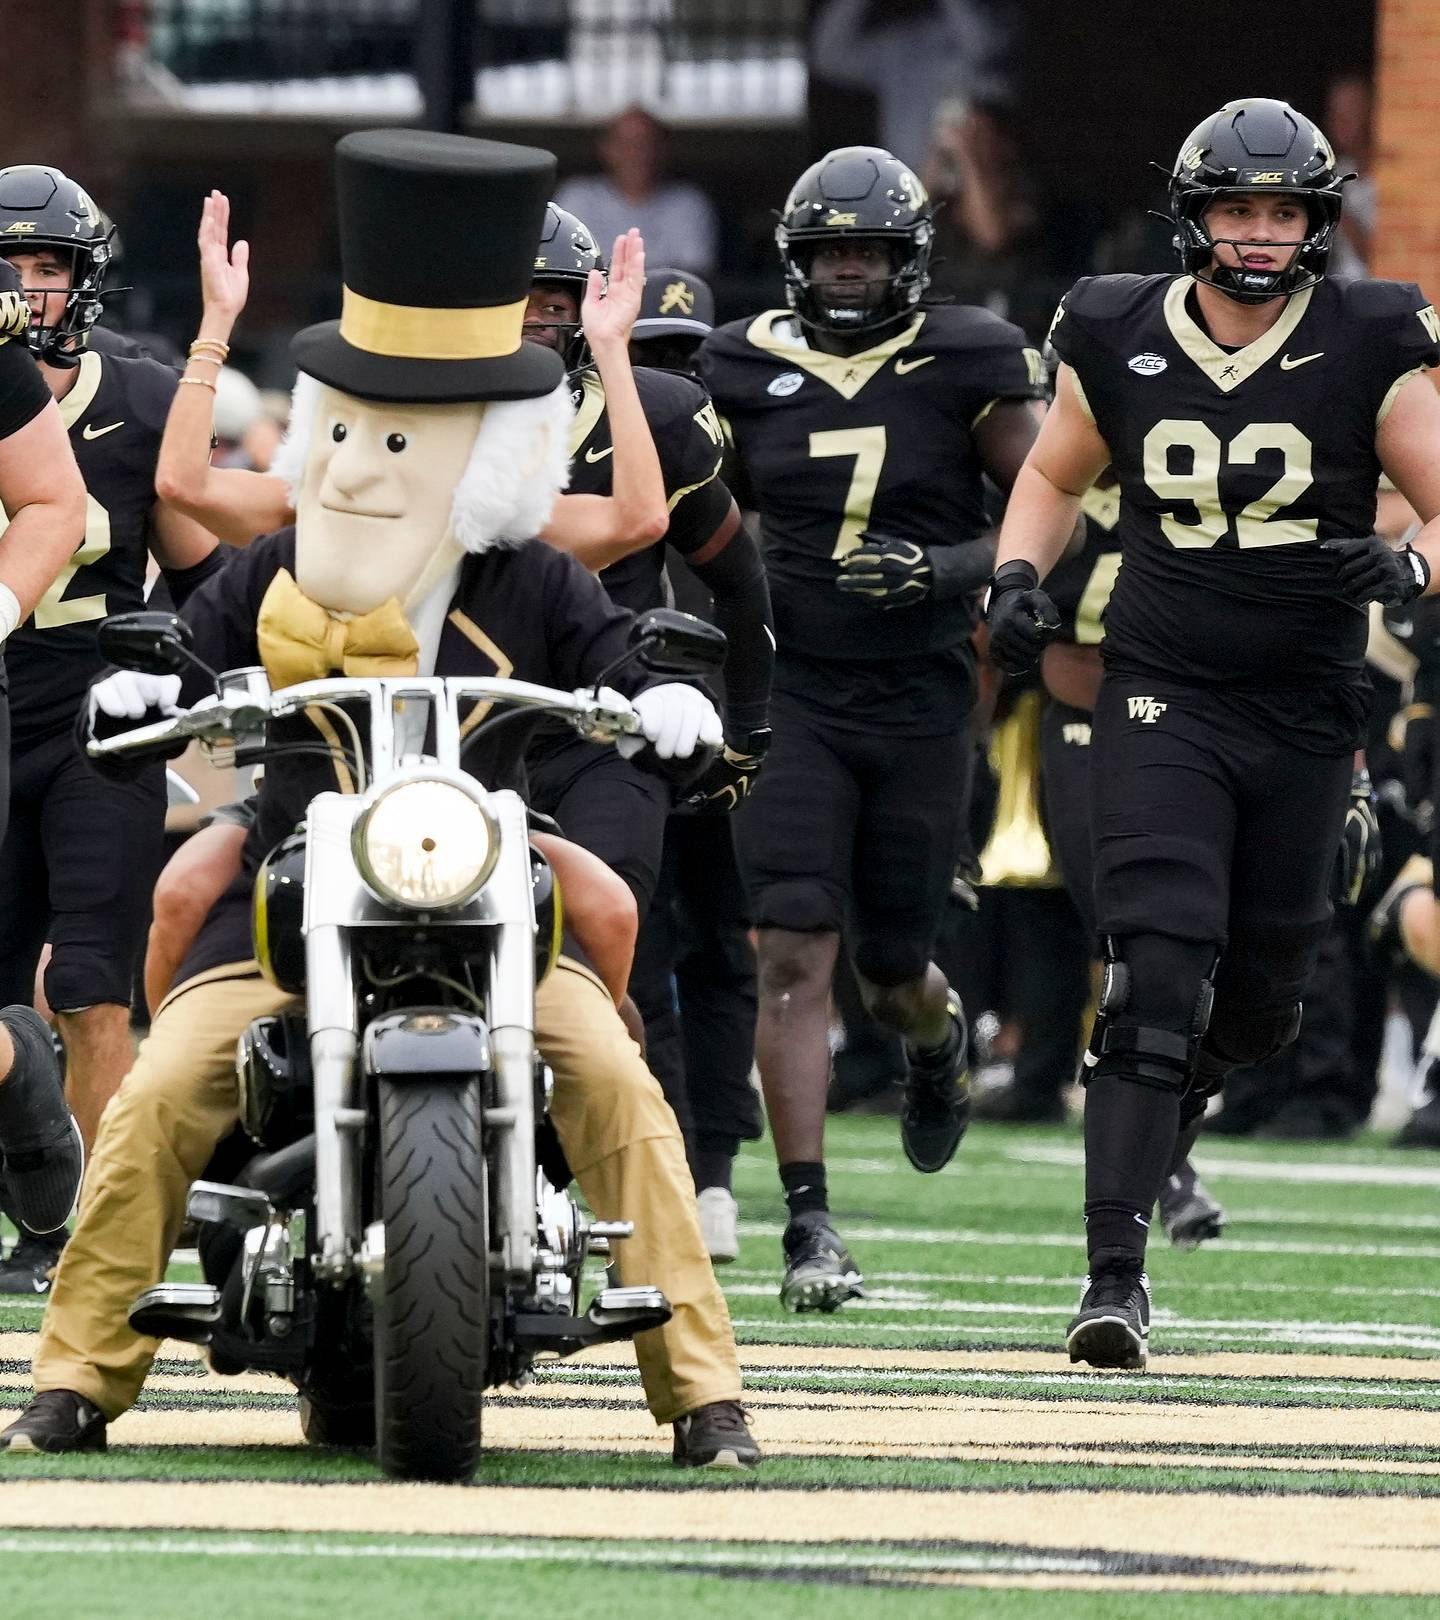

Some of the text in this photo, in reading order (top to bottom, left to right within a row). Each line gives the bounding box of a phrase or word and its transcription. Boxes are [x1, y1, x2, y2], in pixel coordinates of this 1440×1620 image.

[1248, 171, 1285, 184] ACC
[4, 220, 39, 233] ACC
[809, 425, 887, 561] 7
[1143, 418, 1319, 549] 92
[1126, 696, 1168, 724] WF
